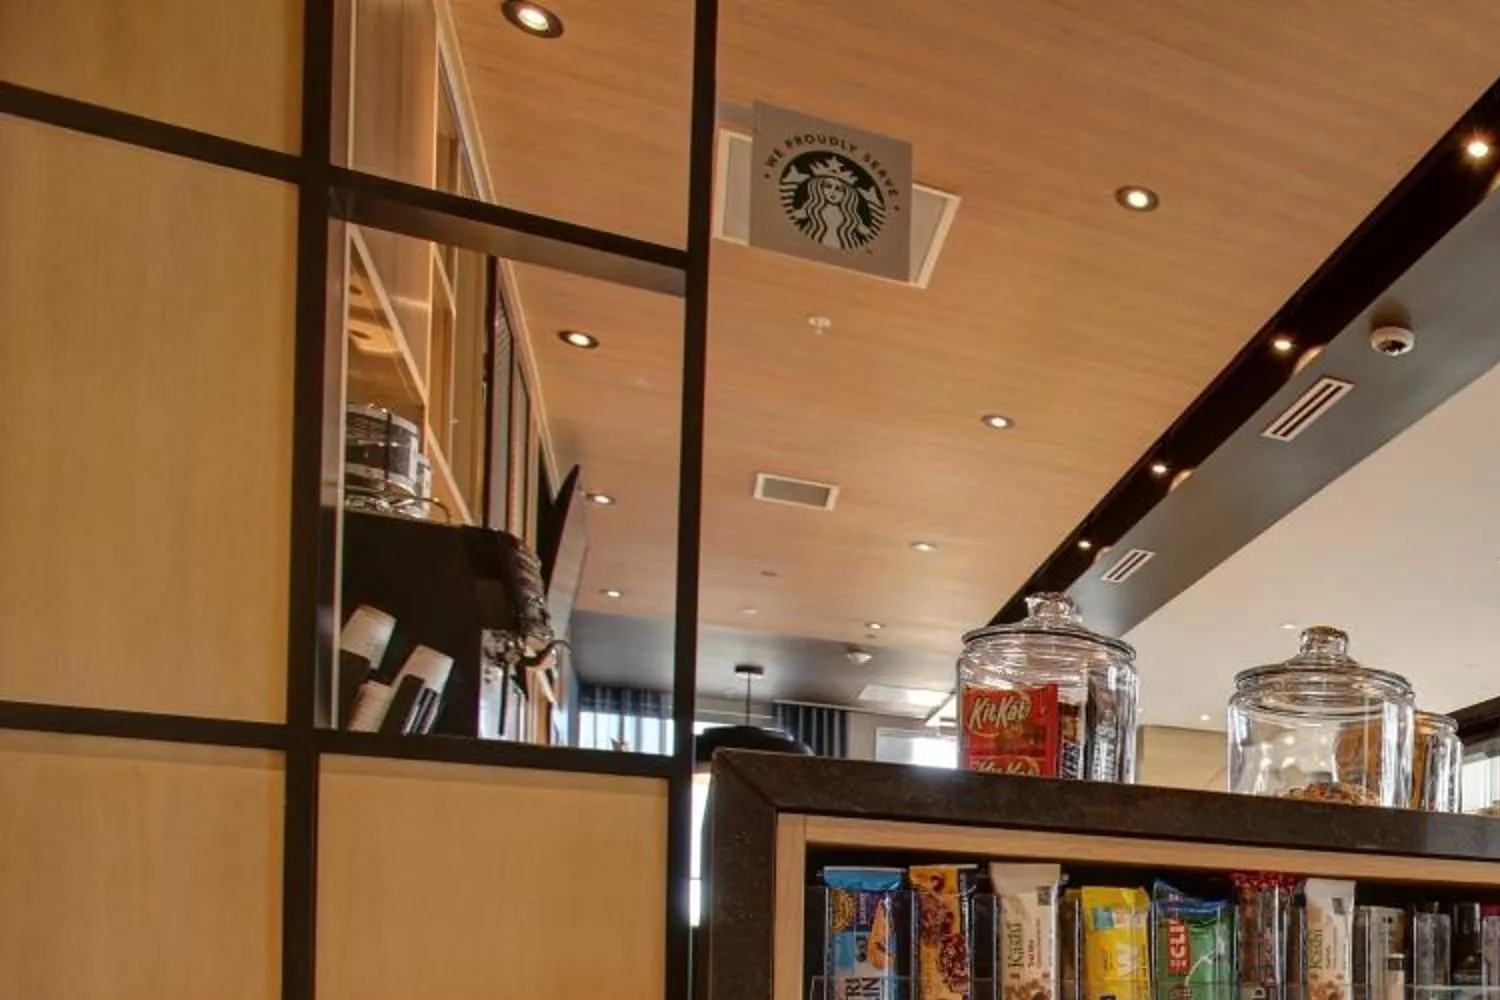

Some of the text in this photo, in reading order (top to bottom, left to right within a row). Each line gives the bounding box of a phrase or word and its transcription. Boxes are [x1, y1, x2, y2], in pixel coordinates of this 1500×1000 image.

[766, 133, 901, 198] WE PROUDLY SERVE
